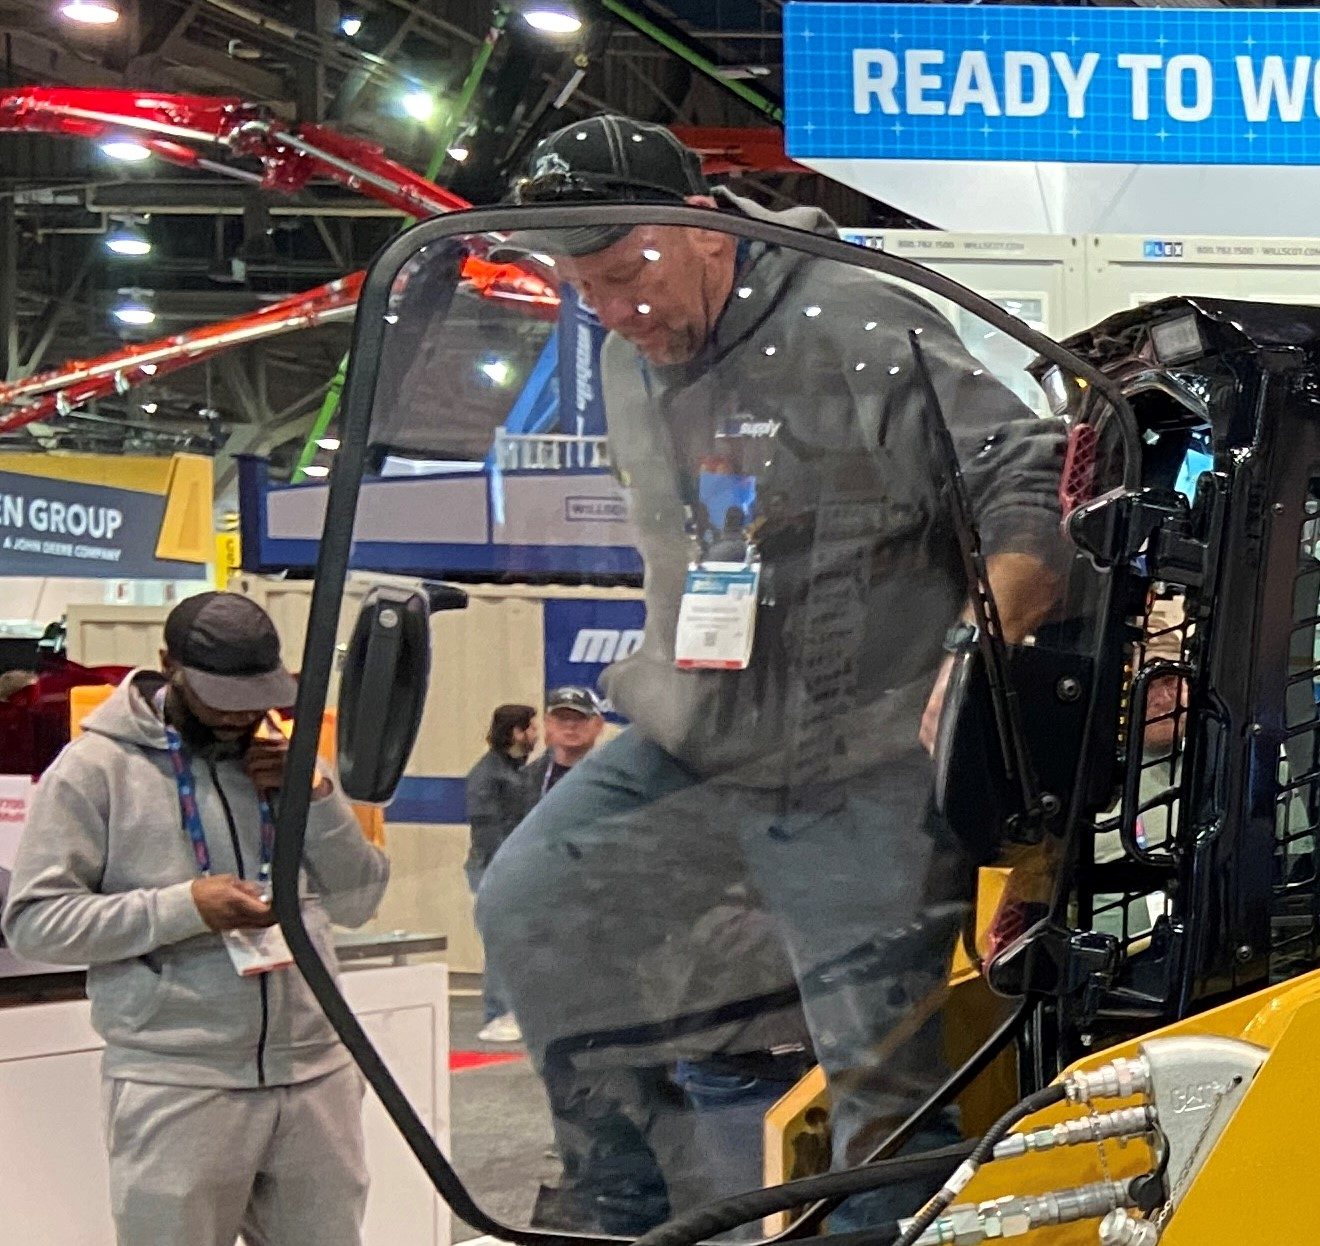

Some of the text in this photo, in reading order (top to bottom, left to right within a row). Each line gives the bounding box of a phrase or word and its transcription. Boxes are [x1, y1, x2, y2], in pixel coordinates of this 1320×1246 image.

[852, 47, 1100, 118] READY
[1117, 53, 1212, 122] TO
[1144, 240, 1183, 258] FLEX
[29, 498, 123, 540] GROUP
